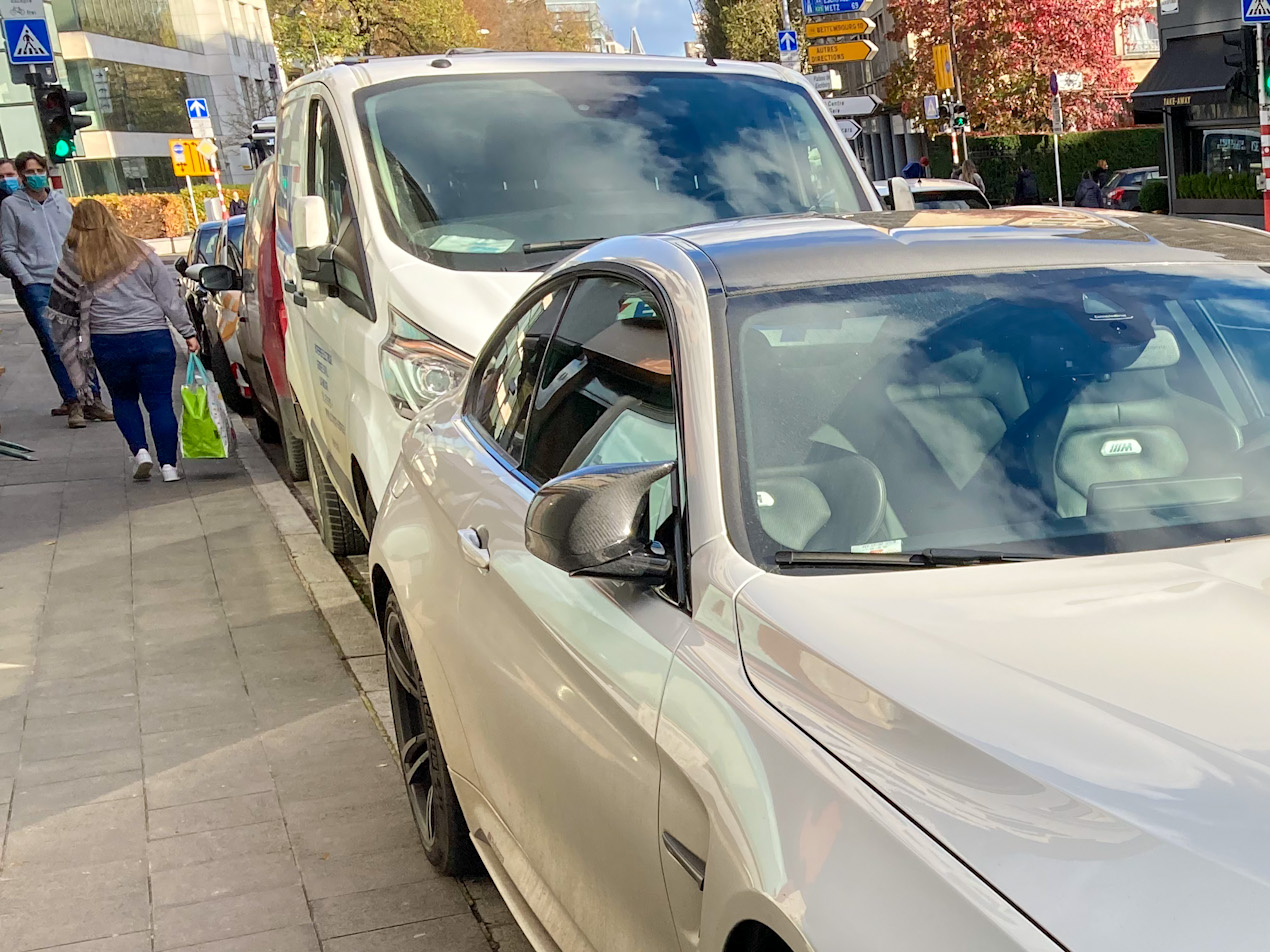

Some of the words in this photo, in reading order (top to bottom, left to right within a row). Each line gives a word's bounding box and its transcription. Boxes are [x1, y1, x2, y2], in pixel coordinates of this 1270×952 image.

[824, 3, 841, 12] METZ
[851, 2, 859, 10] 69
[816, 23, 857, 33] BETTEMBOURG
[816, 45, 838, 54] AUTRES
[811, 54, 845, 63] DIRECTIONS
[1163, 96, 1191, 106] TAKE-AWAY
